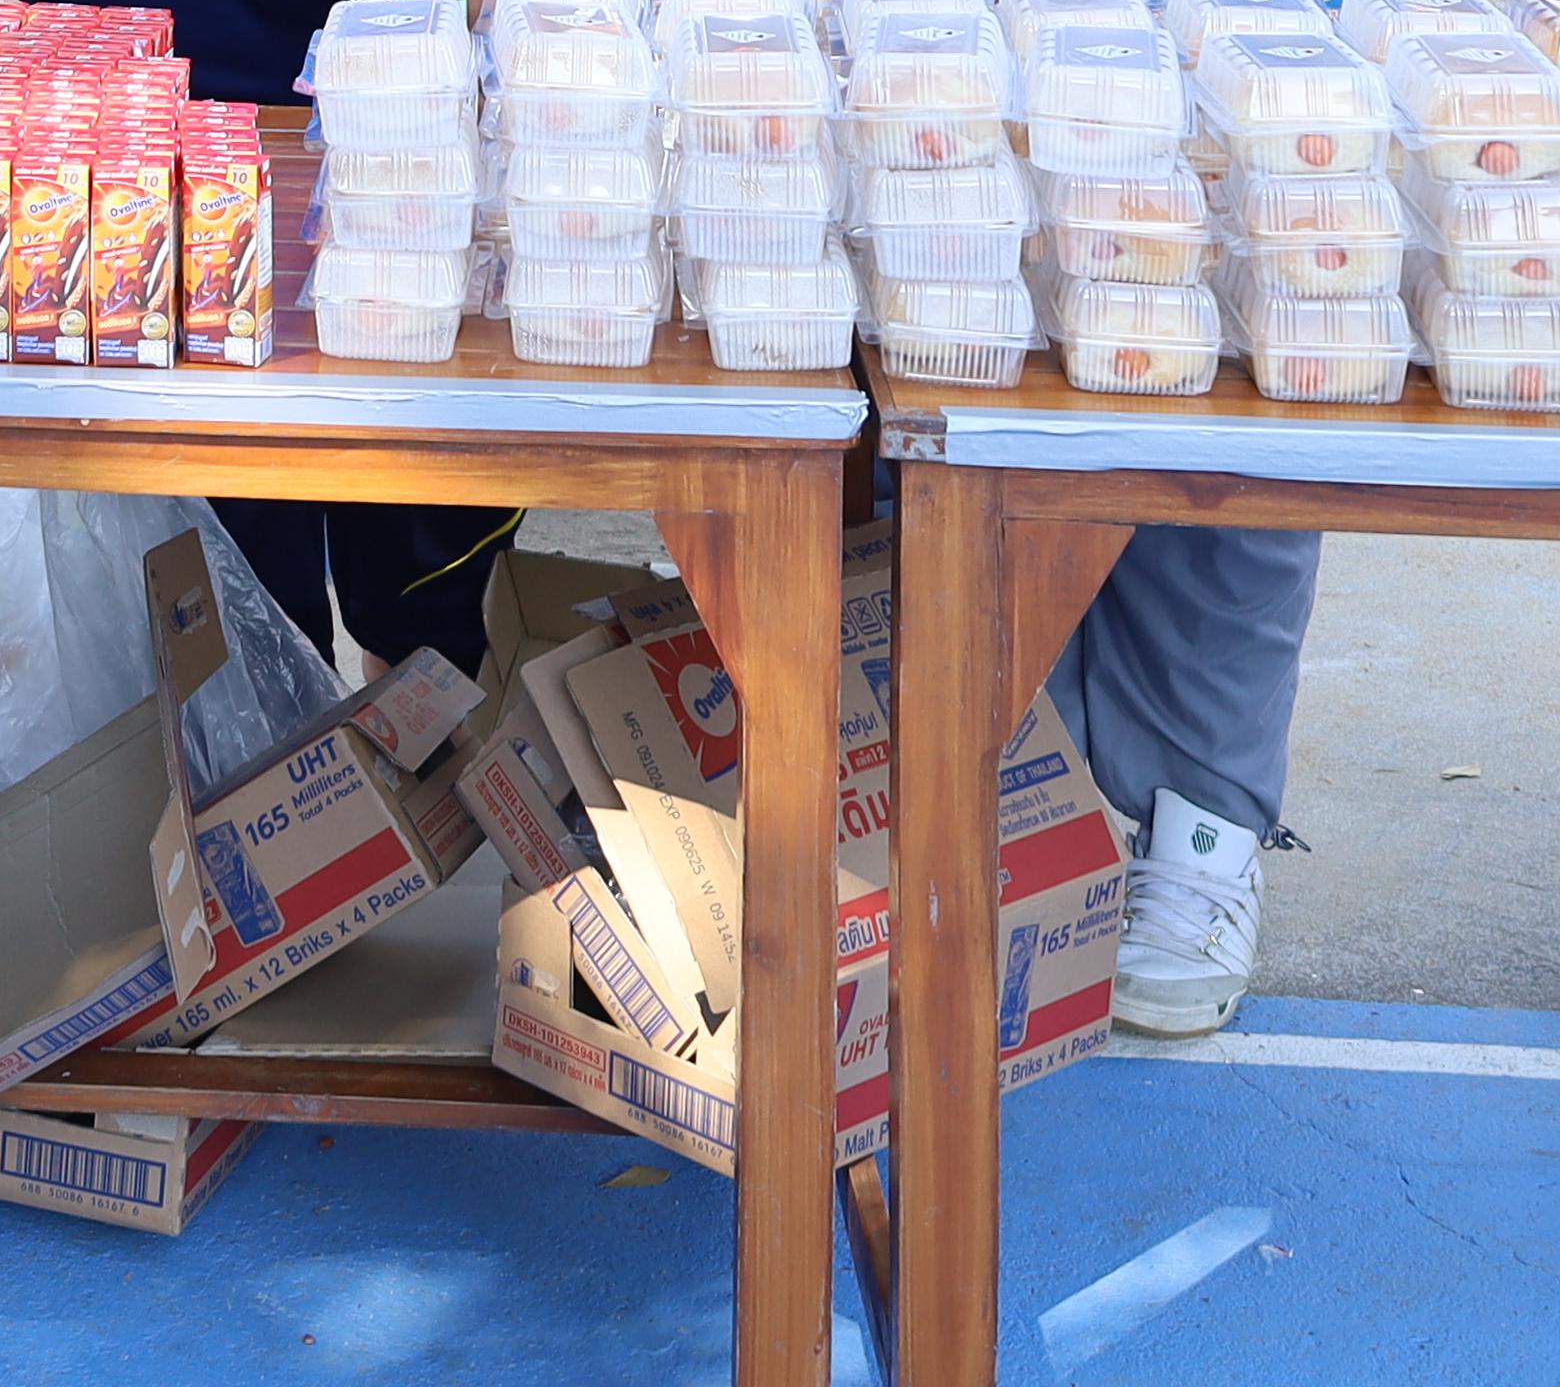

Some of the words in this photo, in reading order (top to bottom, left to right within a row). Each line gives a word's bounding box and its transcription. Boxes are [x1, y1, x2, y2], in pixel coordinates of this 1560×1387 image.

[63, 172, 78, 185] 10
[142, 175, 159, 188] 10
[232, 172, 247, 184] 10
[30, 193, 74, 213] Ovaltine
[110, 198, 153, 219] Ovaltine
[200, 192, 241, 212] Ovaltine
[287, 735, 337, 785] UHT
[292, 762, 356, 809] Milliliters
[299, 801, 323, 823] Total
[326, 796, 334, 807] 4
[334, 779, 365, 803] Packs
[621, 711, 643, 741] MFG
[659, 792, 680, 821] EXP
[675, 826, 705, 876] 090625
[699, 880, 716, 897] W
[245, 803, 291, 846] 165
[1085, 875, 1122, 909] UHT
[176, 1000, 211, 1033] 165
[214, 985, 243, 1014] ml.
[244, 977, 258, 993] x
[260, 957, 286, 982] 12
[285, 928, 335, 967] Briks
[336, 920, 352, 937] x
[353, 906, 367, 925] 4
[368, 873, 429, 915] Packs
[1040, 923, 1073, 957] 165
[507, 1011, 602, 1066] DKSH-101253943
[840, 1035, 879, 1068] UHT
[1010, 1059, 1043, 1086] Briks
[1047, 1054, 1055, 1068] x
[1058, 1047, 1066, 1063] 4
[1070, 1028, 1107, 1056] Packs
[843, 1128, 875, 1157] Malt
[91, 1195, 129, 1211] 16167
[132, 1204, 140, 1216] 6
